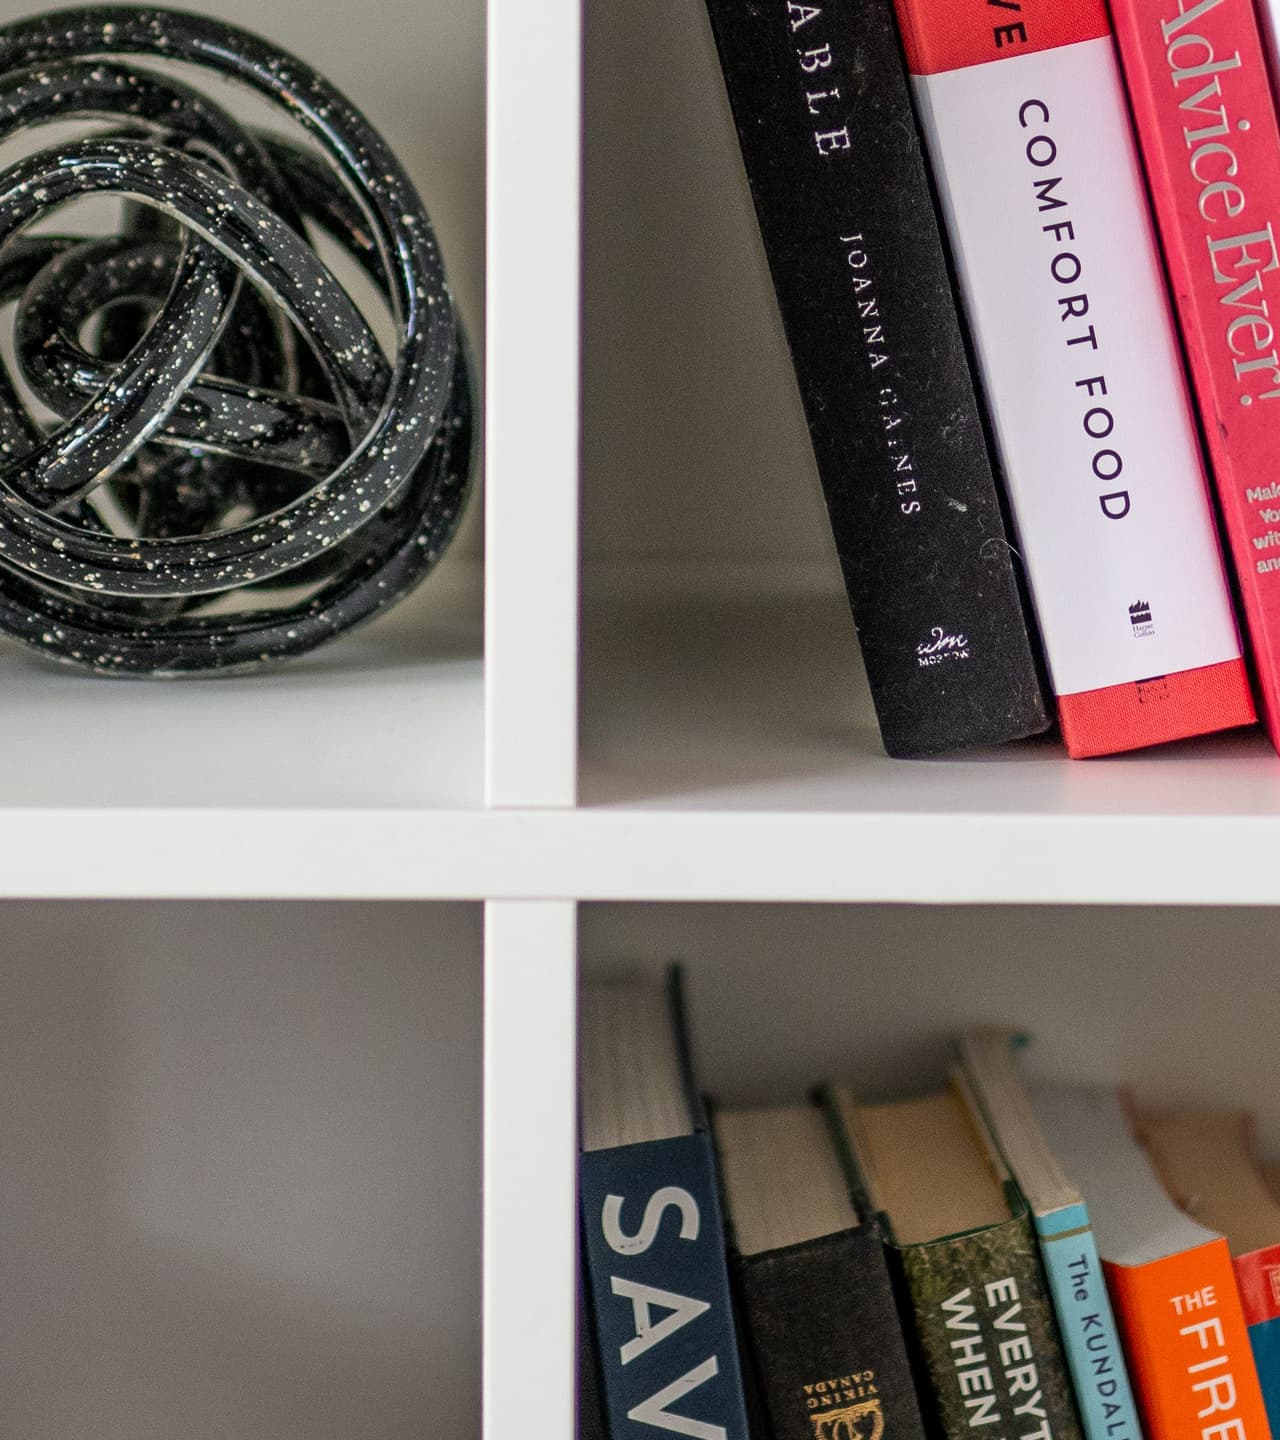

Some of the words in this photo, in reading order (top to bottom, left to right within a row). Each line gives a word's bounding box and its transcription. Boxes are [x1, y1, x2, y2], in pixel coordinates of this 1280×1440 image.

[1019, 100, 1098, 351] COMFORT
[1075, 375, 1131, 521] FOOD
[1066, 1255, 1088, 1302] The
[1169, 1286, 1217, 1317] THE
[940, 1288, 1000, 1427] WHEN
